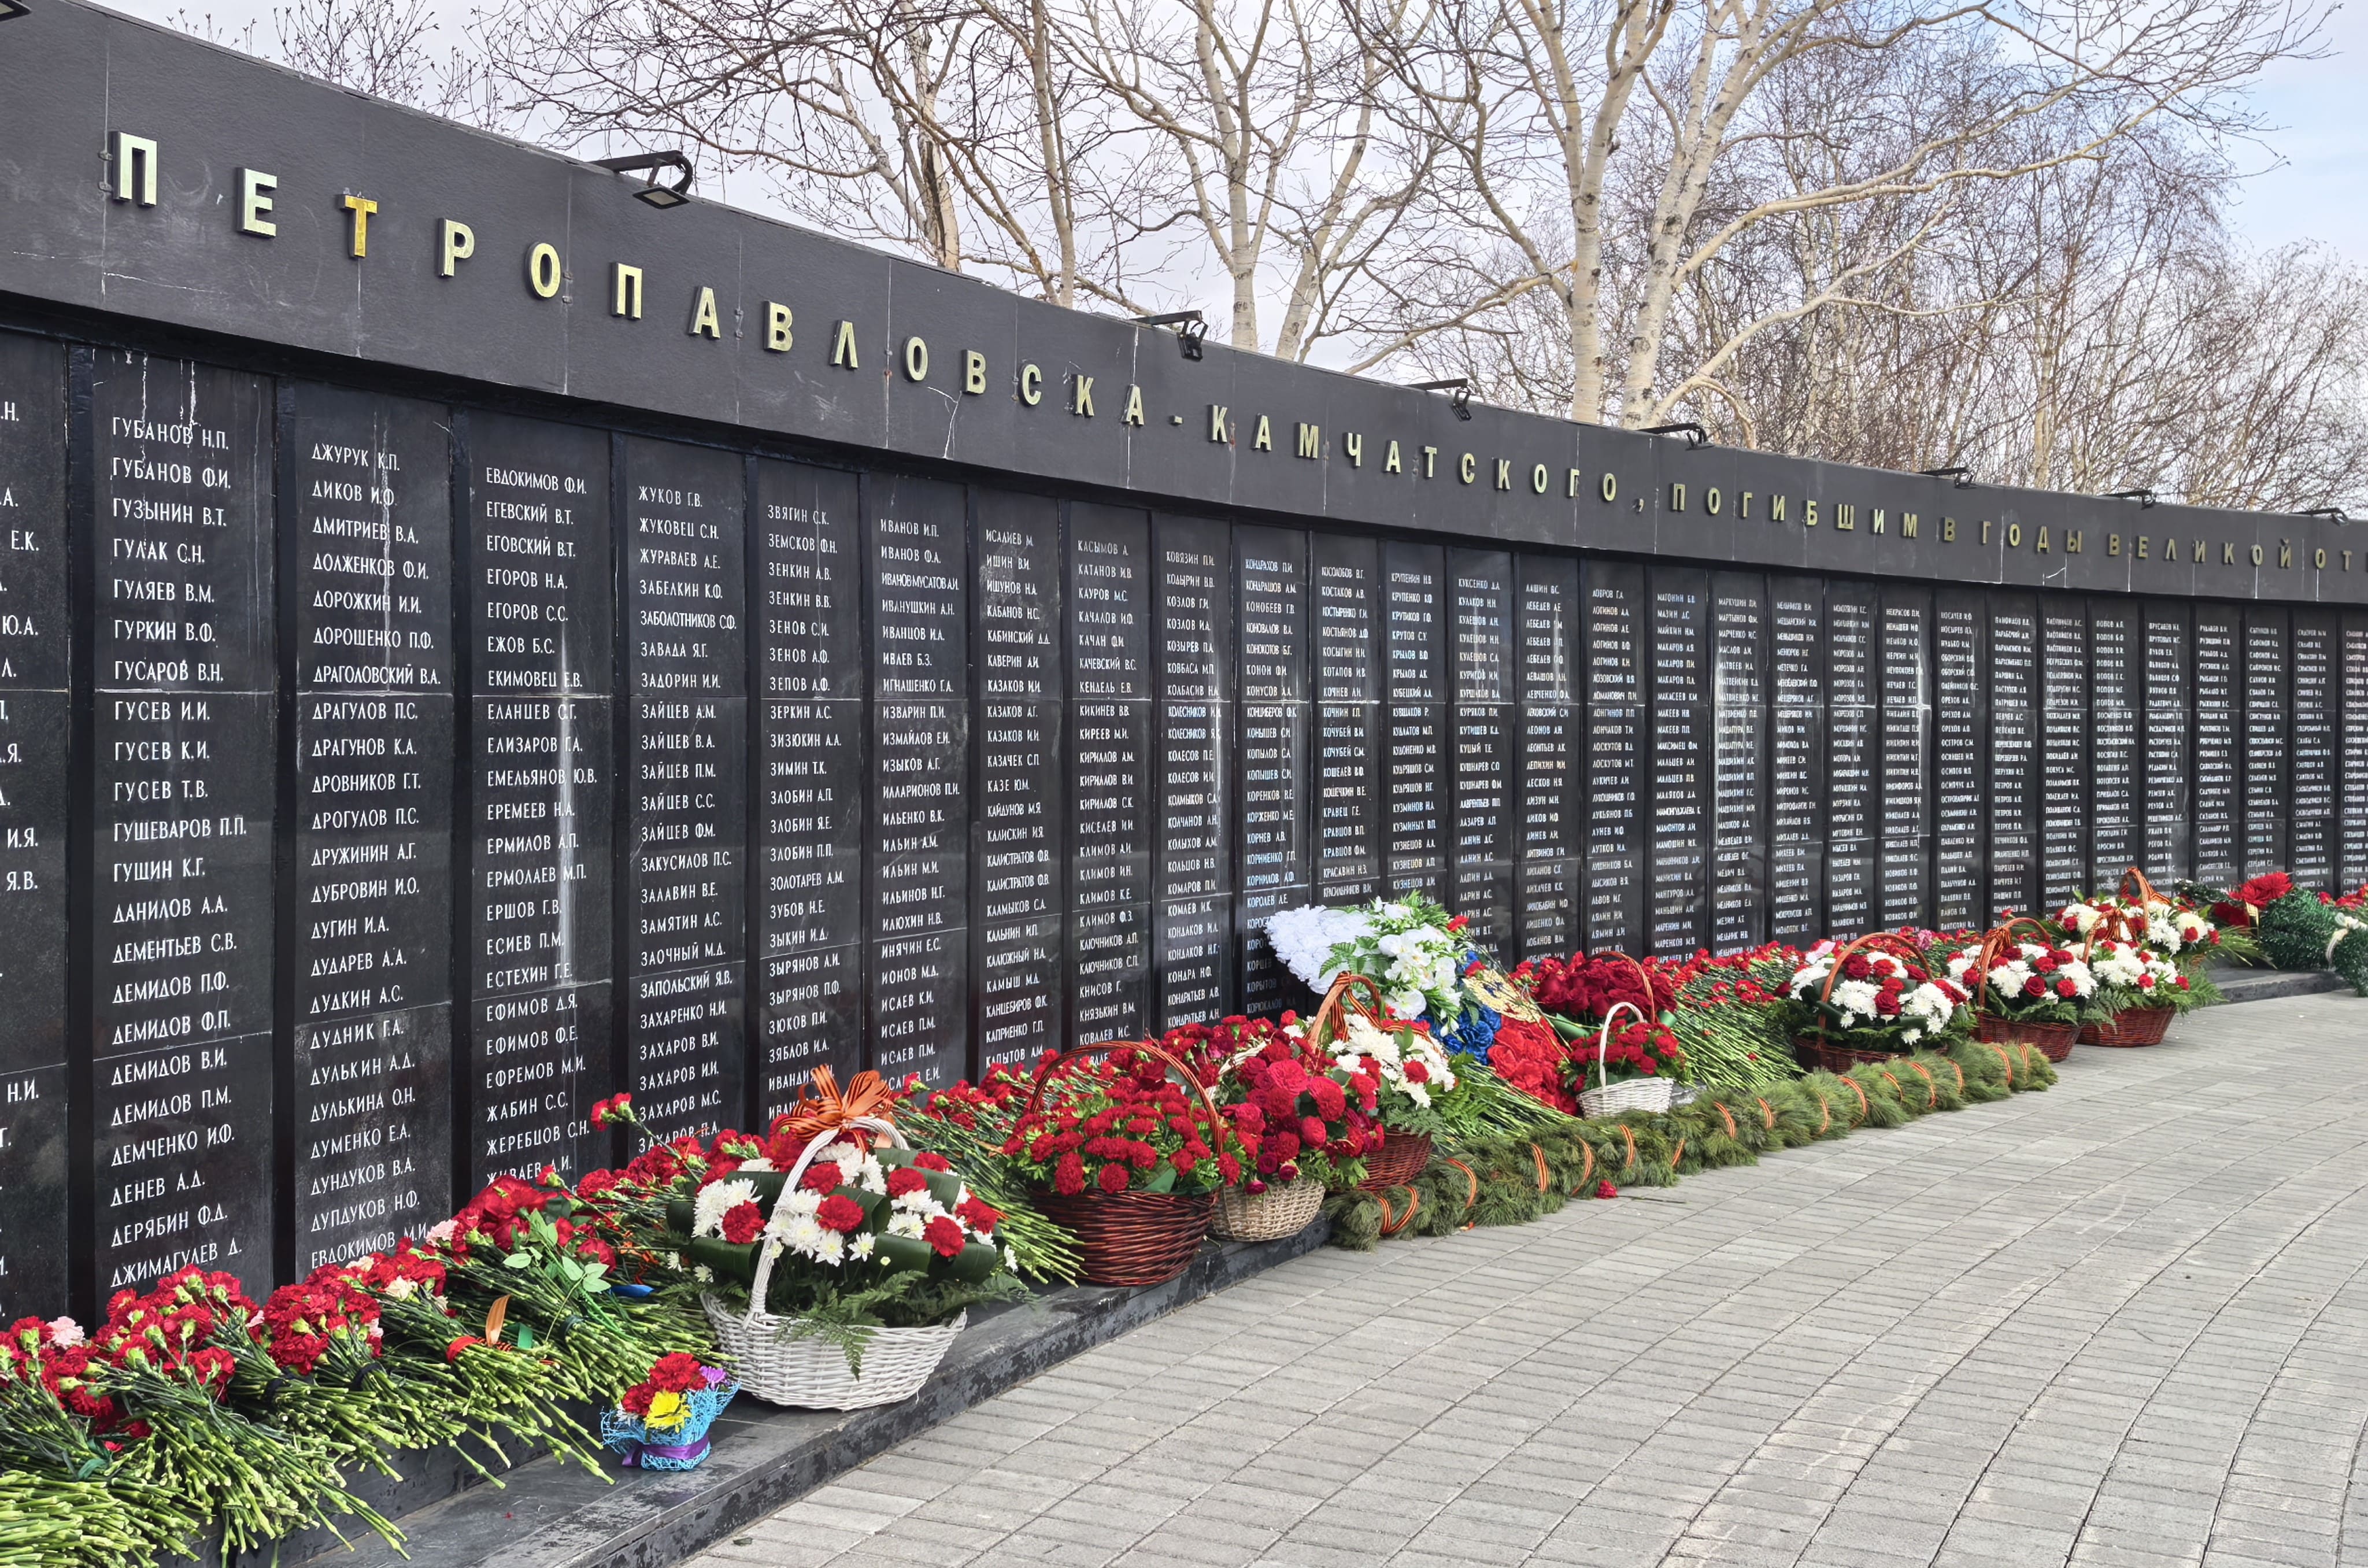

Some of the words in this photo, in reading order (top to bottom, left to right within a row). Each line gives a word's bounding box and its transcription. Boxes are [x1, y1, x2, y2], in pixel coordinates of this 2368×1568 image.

[112, 458, 191, 483] ГУБАНОВ
[202, 465, 231, 490] Ф.И.
[486, 467, 558, 490] ЕВДОКИМОВ
[564, 477, 587, 494] Ф.И.
[639, 486, 681, 505] ЖУКОВ
[113, 498, 193, 525] ГУЗЫНИН
[204, 507, 227, 526] В.Т.
[487, 501, 547, 523] ЕГЕВСКИЙ
[556, 509, 574, 524] В.Т.
[880, 519, 919, 535] ИВАНОВ
[1671, 482, 1918, 539] ПОГИБШИМ
[1943, 516, 1956, 542] В
[1982, 521, 2082, 553] ГОДЫ
[2107, 533, 2292, 568] ВЕЛИКОЙ
[12, 530, 39, 551] Е.К.
[114, 536, 168, 561] ГУЛАК
[177, 543, 205, 564] С.Н.
[487, 535, 550, 556] ЕГОВСКИЙ
[557, 541, 575, 559] В.Т.
[313, 552, 395, 578] ДОЛЖЕНКОВ
[403, 561, 428, 579] Ф.И.
[1078, 564, 1116, 577] КАТАНОВ
[487, 569, 538, 587] ЕГОРОВ
[546, 573, 568, 589] Н.А.
[639, 579, 698, 597] ЗАБЕЛКИН
[114, 578, 175, 601] ГУЛЯЕВ
[186, 583, 214, 603] В.М.
[769, 591, 809, 607] ЗЕНКИН
[1079, 587, 1109, 600] КАУРОВ
[2, 615, 38, 635] Ю.А.
[114, 620, 176, 641] ГУРКИН
[186, 621, 216, 642] В.Ф.
[313, 626, 401, 649] ДОРОШЕНКО
[409, 631, 434, 649] П.Ф.
[488, 637, 525, 653] ЕЖОВ
[533, 638, 555, 654] Б.С.
[641, 642, 686, 657] ЗАВАДА
[115, 657, 188, 683] ГУСАРОВ
[198, 663, 223, 683] В.Н.
[642, 672, 696, 688] ЗАДОРИН
[115, 701, 171, 722] ГУСЕВ
[182, 701, 210, 720] И.И.
[312, 702, 386, 719] ДРАГУЛОВ
[395, 702, 418, 719] П.С.
[883, 706, 925, 719] ИЗВАРИН
[987, 705, 1022, 718] КАЗАКОВ
[115, 742, 171, 761] ГУСЕВ
[182, 741, 210, 761] К.И.
[312, 738, 385, 756] ДРАГУНОВ
[394, 738, 417, 755] К.А.
[988, 755, 1023, 767] КАЗАЧЕК
[115, 779, 171, 803] ГУСЕВ
[182, 780, 208, 800] Т.В.
[312, 773, 395, 793] ДРОВНИКОВ
[404, 772, 421, 789] Г.Т.
[988, 779, 1009, 793] КАЗЕ
[771, 818, 812, 833] ЗЛОБИН
[883, 811, 925, 826] ИЛЬЕНКО
[8, 827, 38, 849] И.Я.
[311, 845, 388, 866] ДРУЖИНИН
[397, 843, 416, 861] А.Г.
[642, 853, 708, 872] ЗАКУСИЛОВ
[6, 871, 38, 891] Я.В.
[311, 879, 387, 903] ДУБРОВИН
[395, 877, 419, 895] И.О.
[770, 873, 822, 891] ЗОЛОТАРЕВ
[113, 898, 191, 923] ДАНИЛОВ
[201, 895, 228, 914] А.А.
[487, 902, 535, 921] ЕРШОВ
[311, 918, 356, 939] ДУГИН
[365, 916, 389, 934] И.А.
[641, 915, 697, 934] ЗАМЯТИН
[112, 936, 201, 963] ДЕМЕНТЬЕВ
[211, 933, 237, 952] С.В.
[641, 942, 698, 966] ЗАОЧНЫЙ
[311, 953, 373, 977] ДУДАРЕВ
[382, 948, 406, 967] А.А.
[882, 967, 916, 985] ИОНОВ
[112, 976, 191, 1004] ДЕМИДОВ
[201, 971, 229, 993] П.Ф.
[769, 985, 819, 1006] ЗЫРЯНОВ
[310, 989, 370, 1014] ДУДКИН
[379, 985, 403, 1004] А.С.
[882, 994, 914, 1012] ИСАЕВ
[641, 1004, 703, 1029] ЗАХАРЕНКО
[769, 1015, 806, 1034] ЗЮКОВ
[487, 1031, 548, 1055] ЕФИМОВ
[640, 1036, 695, 1060] ЗАХАРОВ
[487, 1062, 553, 1089] ЕФРЕМОВ
[8, 1077, 39, 1104] Н.И.
[486, 1097, 536, 1122] ЖАБИН
[111, 1131, 198, 1167] ДЕМЧЕНКО
[207, 1124, 235, 1148] И.Ф.
[310, 1127, 381, 1159] ДУМЕНКО
[111, 1211, 188, 1249] ДЕРЯБИН
[198, 1203, 228, 1227] Ф.Д.
